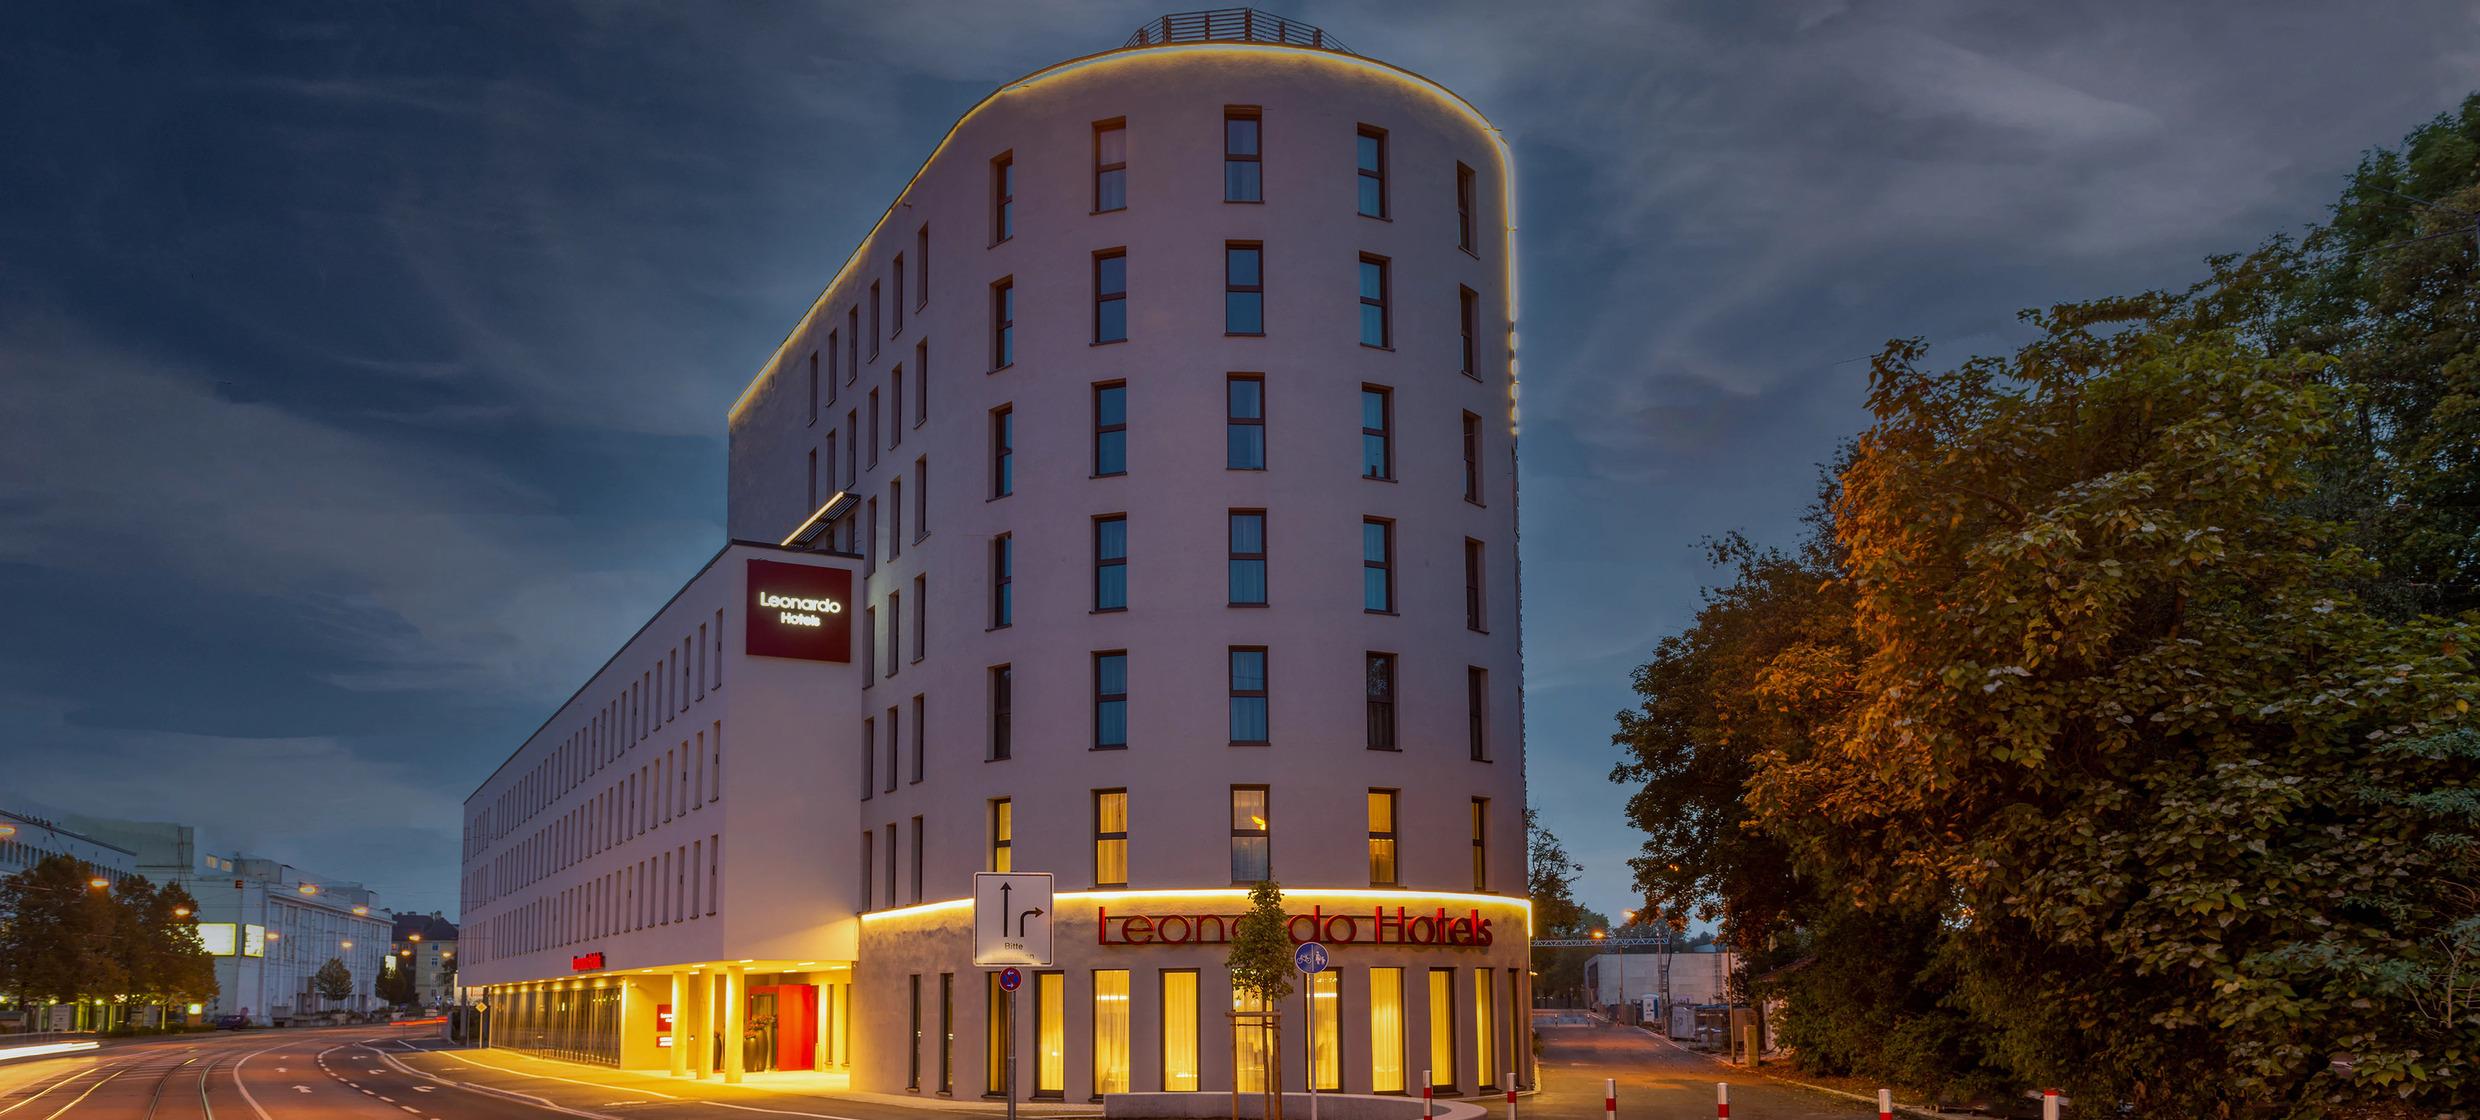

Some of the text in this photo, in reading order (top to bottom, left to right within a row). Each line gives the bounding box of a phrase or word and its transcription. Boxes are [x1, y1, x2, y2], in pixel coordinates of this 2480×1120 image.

[760, 591, 841, 614] Leonardo
[780, 611, 821, 627] Hotels
[1099, 905, 1493, 946] Leondo Hotels
[1004, 942, 1024, 950] Bitte
